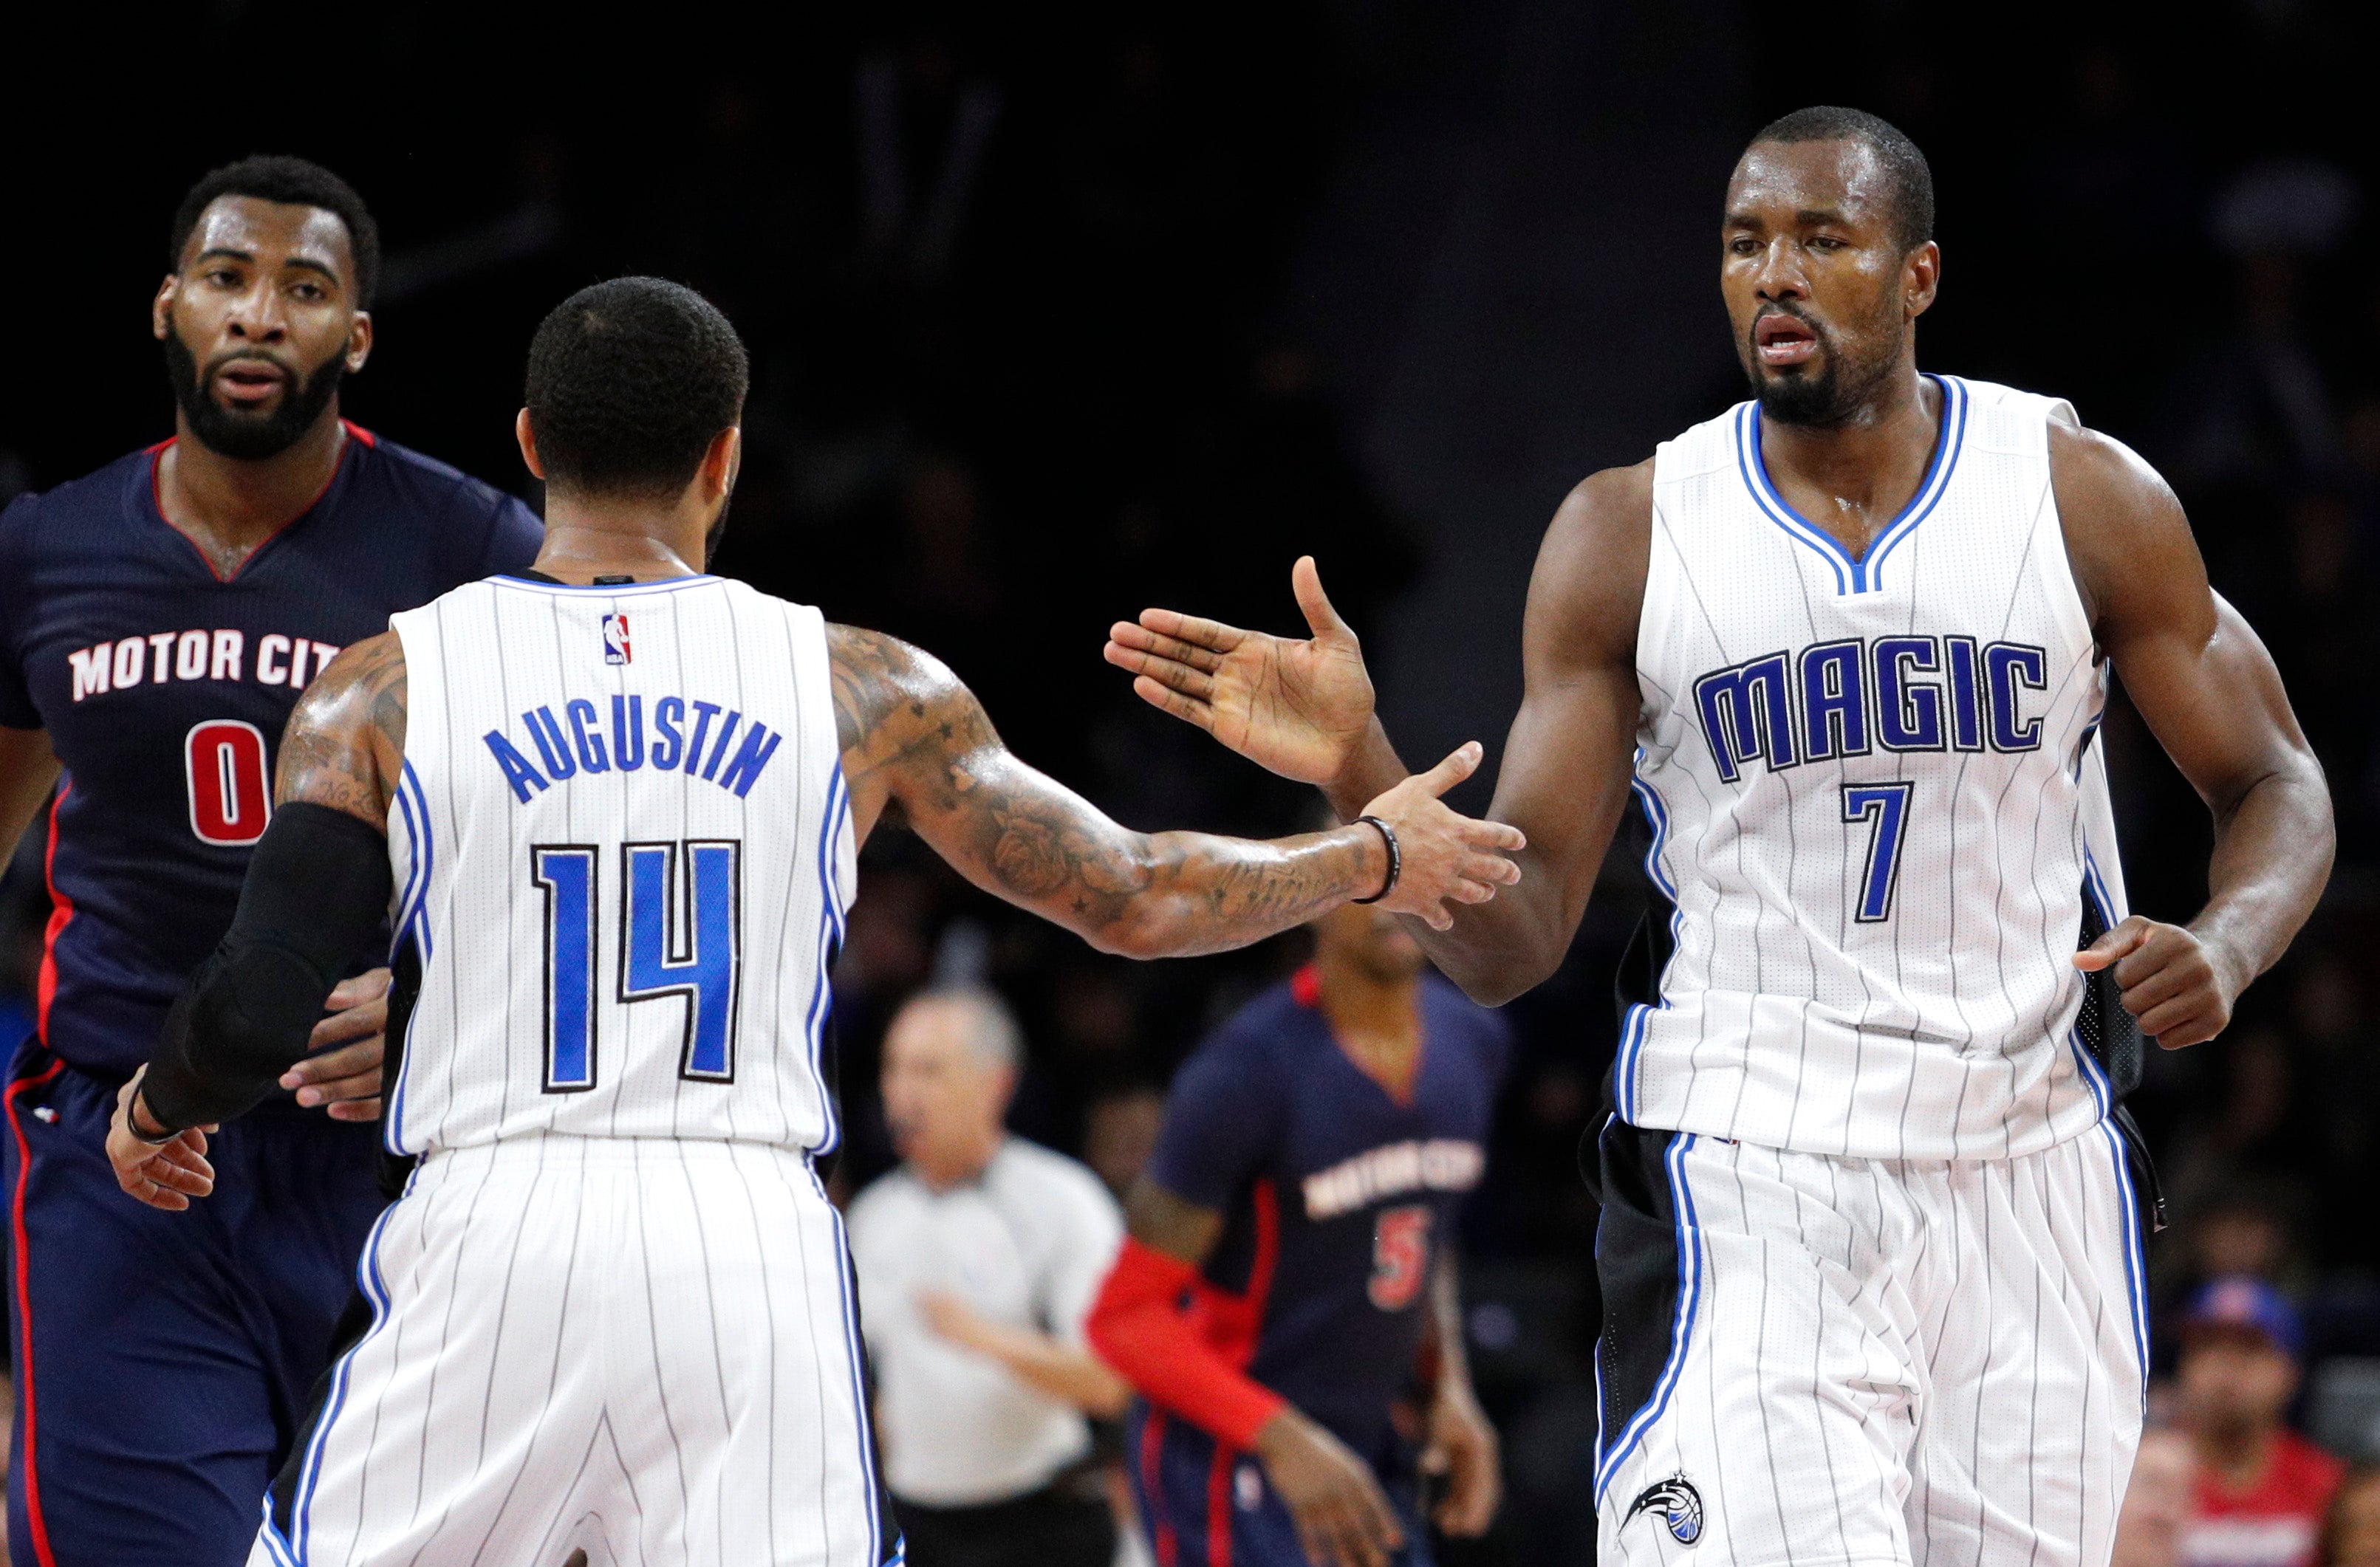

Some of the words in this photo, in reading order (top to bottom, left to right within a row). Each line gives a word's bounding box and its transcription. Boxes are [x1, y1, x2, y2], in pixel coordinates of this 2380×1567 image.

[68, 628, 245, 702] MOTOR
[256, 632, 341, 690] CIT
[1692, 634, 2046, 784] MAGIC
[185, 719, 271, 846] 0
[483, 695, 782, 805] AUGUSTIN
[1841, 781, 1914, 923] 7
[530, 840, 741, 1093] 14
[1368, 1205, 1430, 1311] 5
